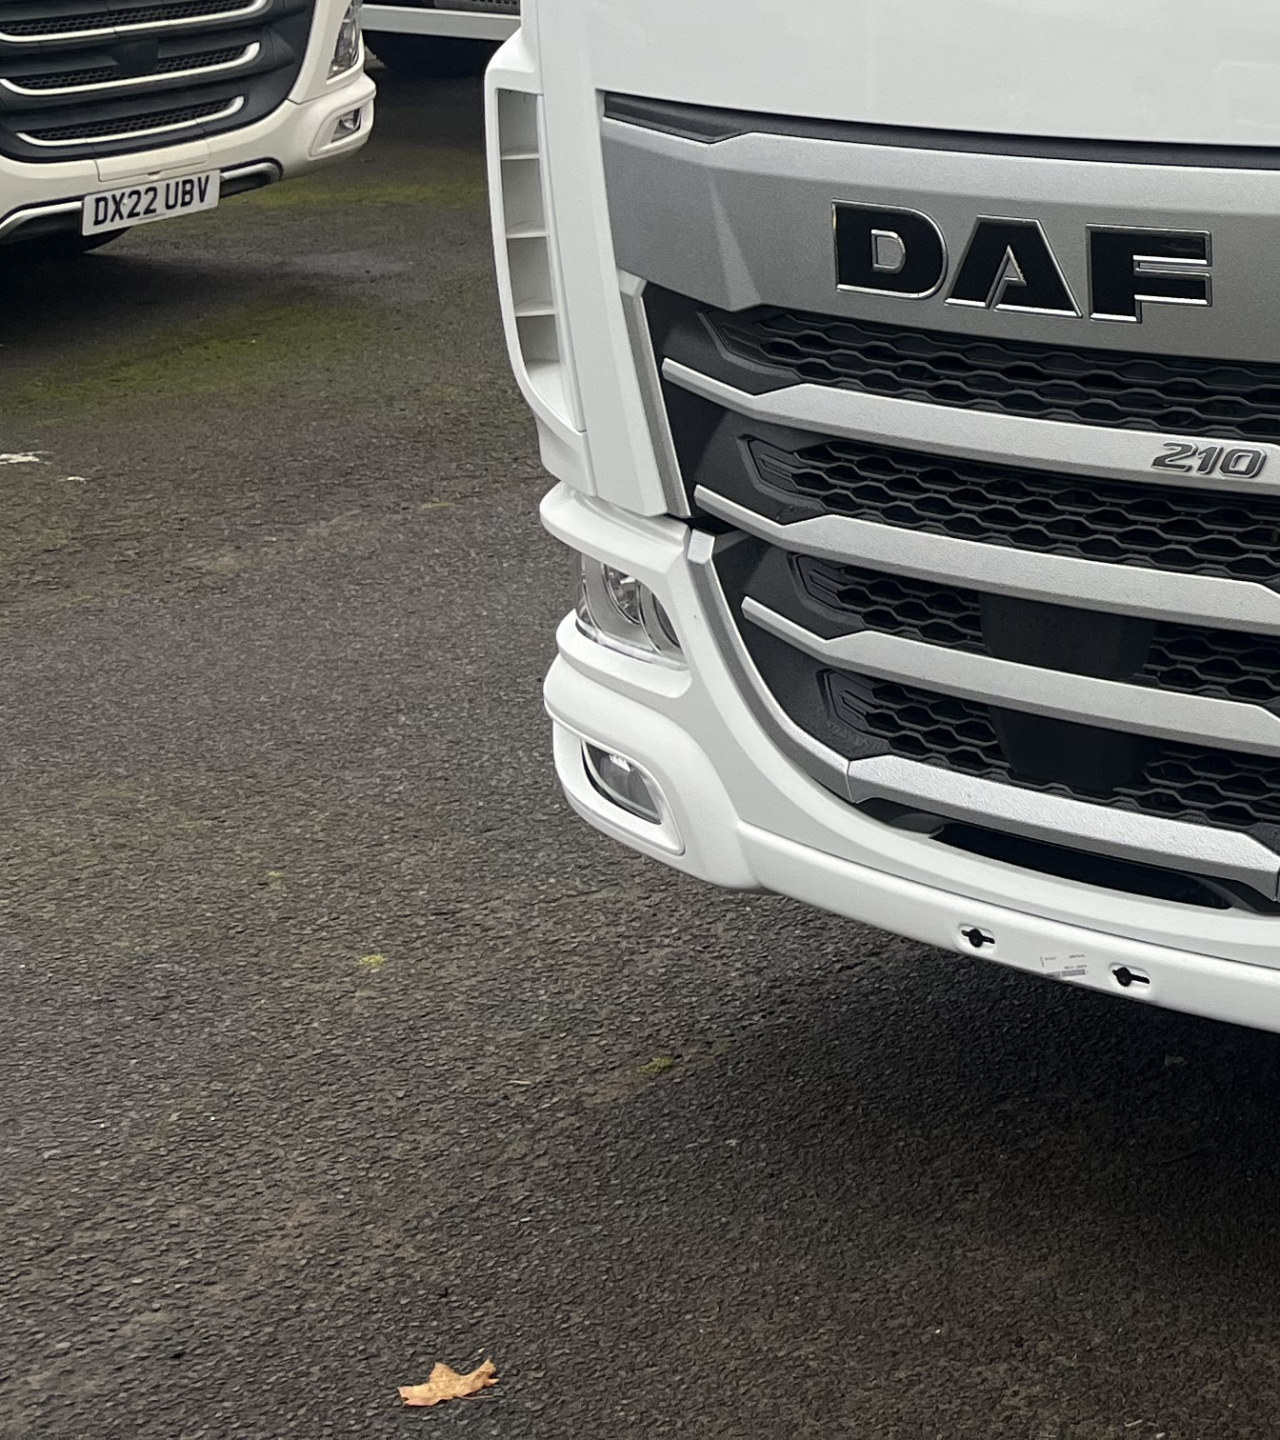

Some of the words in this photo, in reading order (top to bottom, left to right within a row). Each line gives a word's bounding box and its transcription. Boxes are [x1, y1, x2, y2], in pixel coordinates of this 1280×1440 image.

[93, 186, 158, 226] DX22
[165, 175, 210, 210] UBV
[832, 198, 1213, 324] DAF
[1151, 442, 1267, 478] 210
